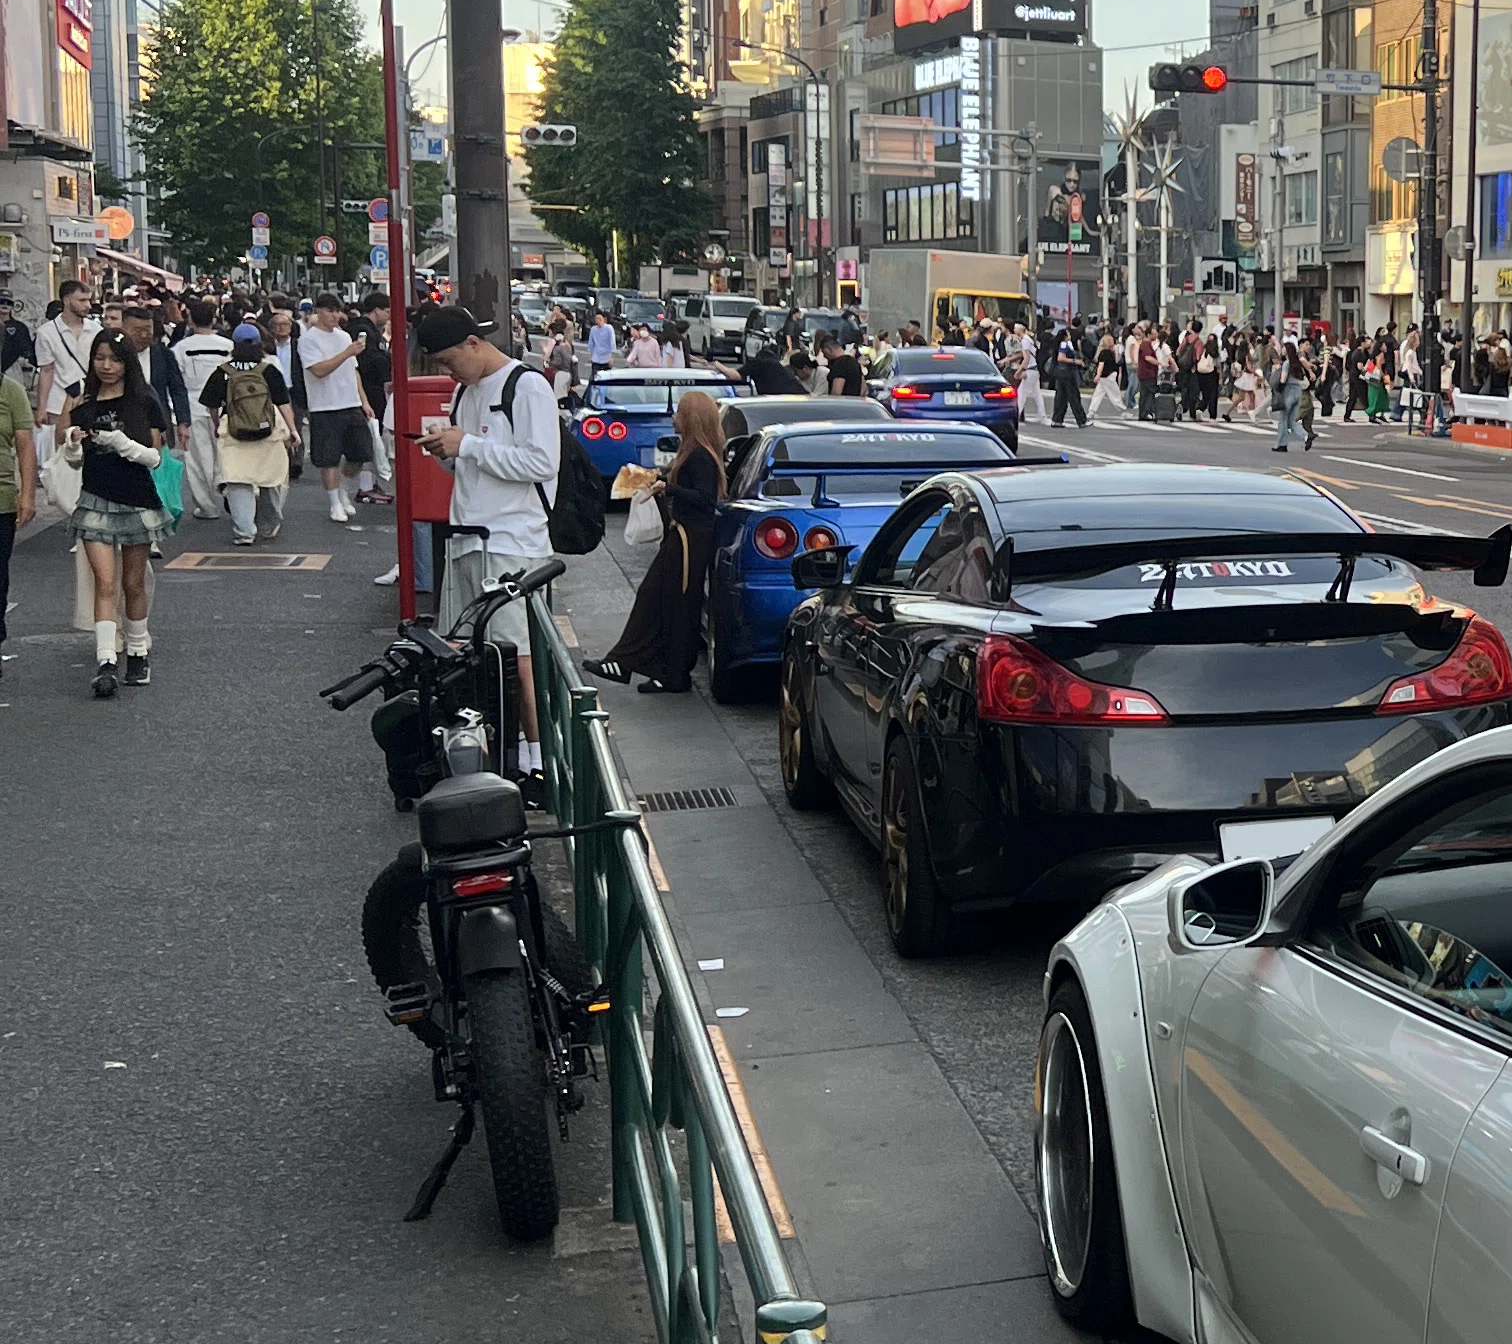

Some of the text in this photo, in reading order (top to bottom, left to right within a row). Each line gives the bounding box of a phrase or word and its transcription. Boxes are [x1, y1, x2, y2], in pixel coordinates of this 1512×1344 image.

[961, 37, 980, 91] BLUE
[961, 94, 980, 201] ELEPHANT
[1050, 242, 1090, 253] ELEPANT
[1138, 560, 1297, 583] 27TOKYO
